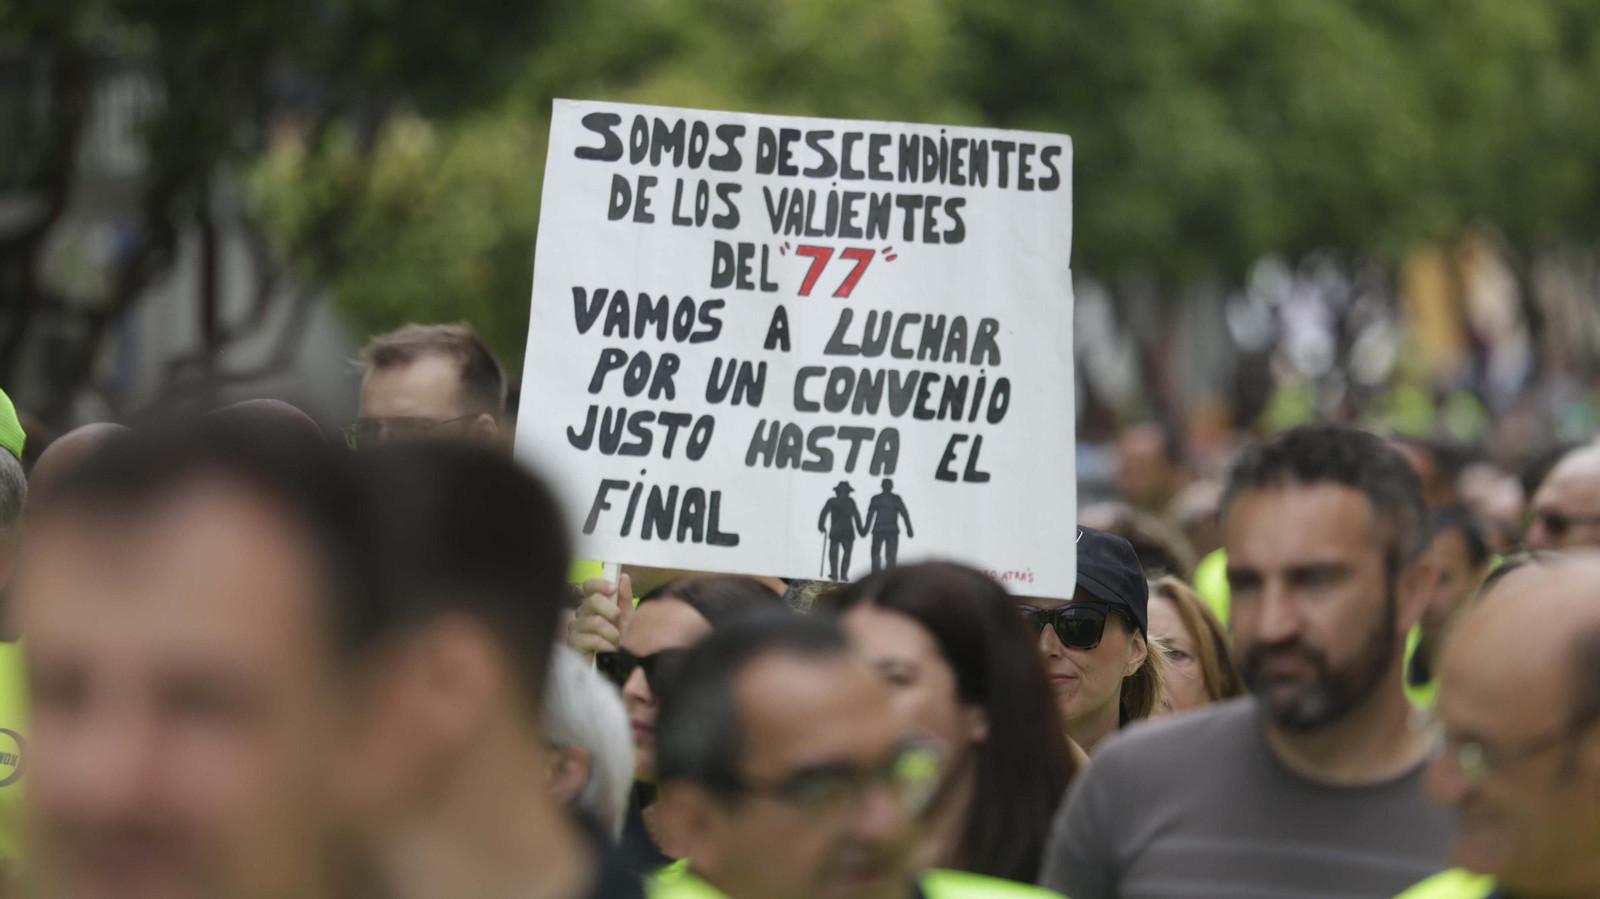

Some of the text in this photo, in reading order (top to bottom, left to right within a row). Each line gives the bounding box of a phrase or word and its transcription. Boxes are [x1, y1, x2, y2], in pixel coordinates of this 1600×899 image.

[574, 112, 1062, 192] SOMOS DESCENDIENTES
[607, 173, 967, 245] DE LOS VALIENTES
[710, 240, 779, 293] DEL
[571, 286, 1001, 366] VAMOS A LUCHAR
[587, 347, 1011, 425] POR UN CONVENIO
[566, 404, 991, 483] JUSTO HASTA EL
[582, 468, 740, 547] FINAL
